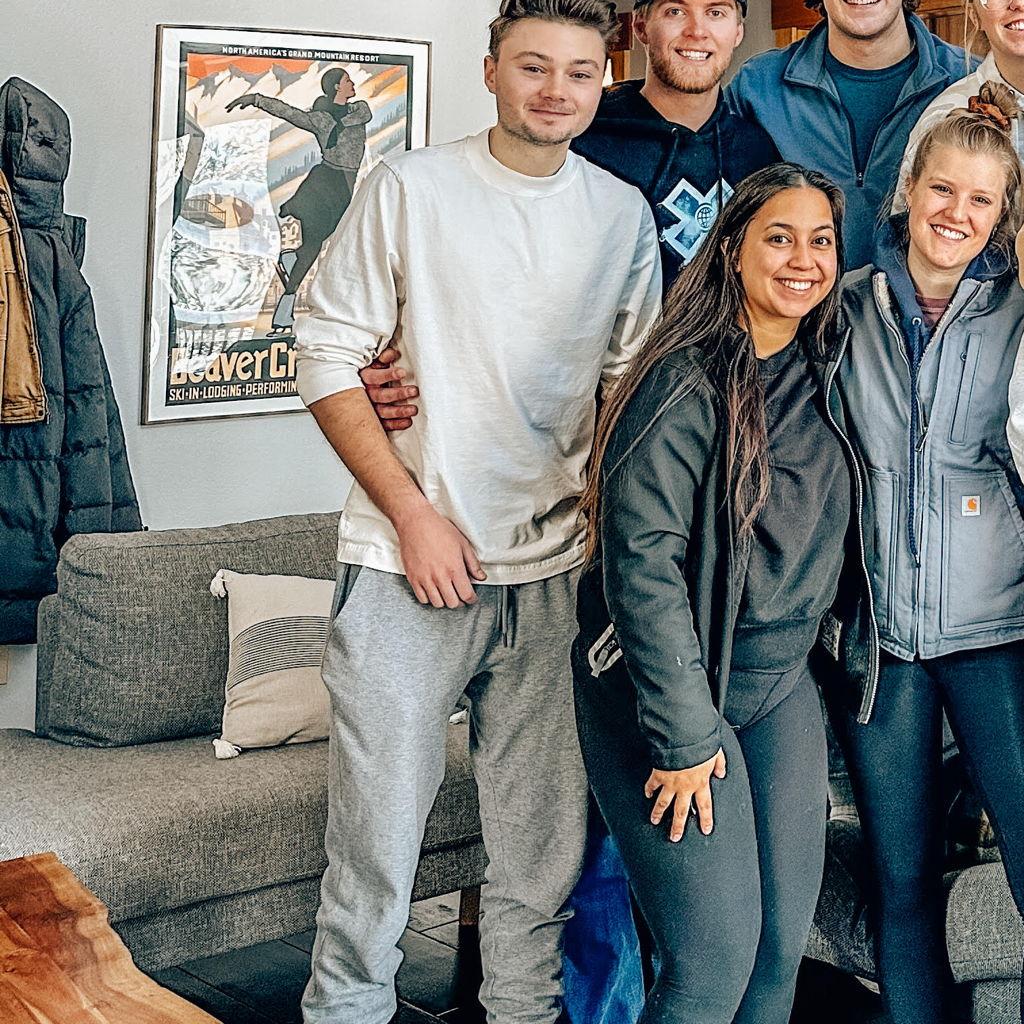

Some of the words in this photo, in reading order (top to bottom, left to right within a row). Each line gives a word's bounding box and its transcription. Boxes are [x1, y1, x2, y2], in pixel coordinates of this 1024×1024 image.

[222, 46, 247, 55] NORTH
[247, 47, 287, 57] AMERICA'S
[288, 50, 313, 59] GRAND
[314, 51, 350, 60] MOUNTAIN
[350, 54, 380, 62] RESORT
[169, 347, 269, 385] Beaver
[245, 380, 297, 396] PERFORMIN
